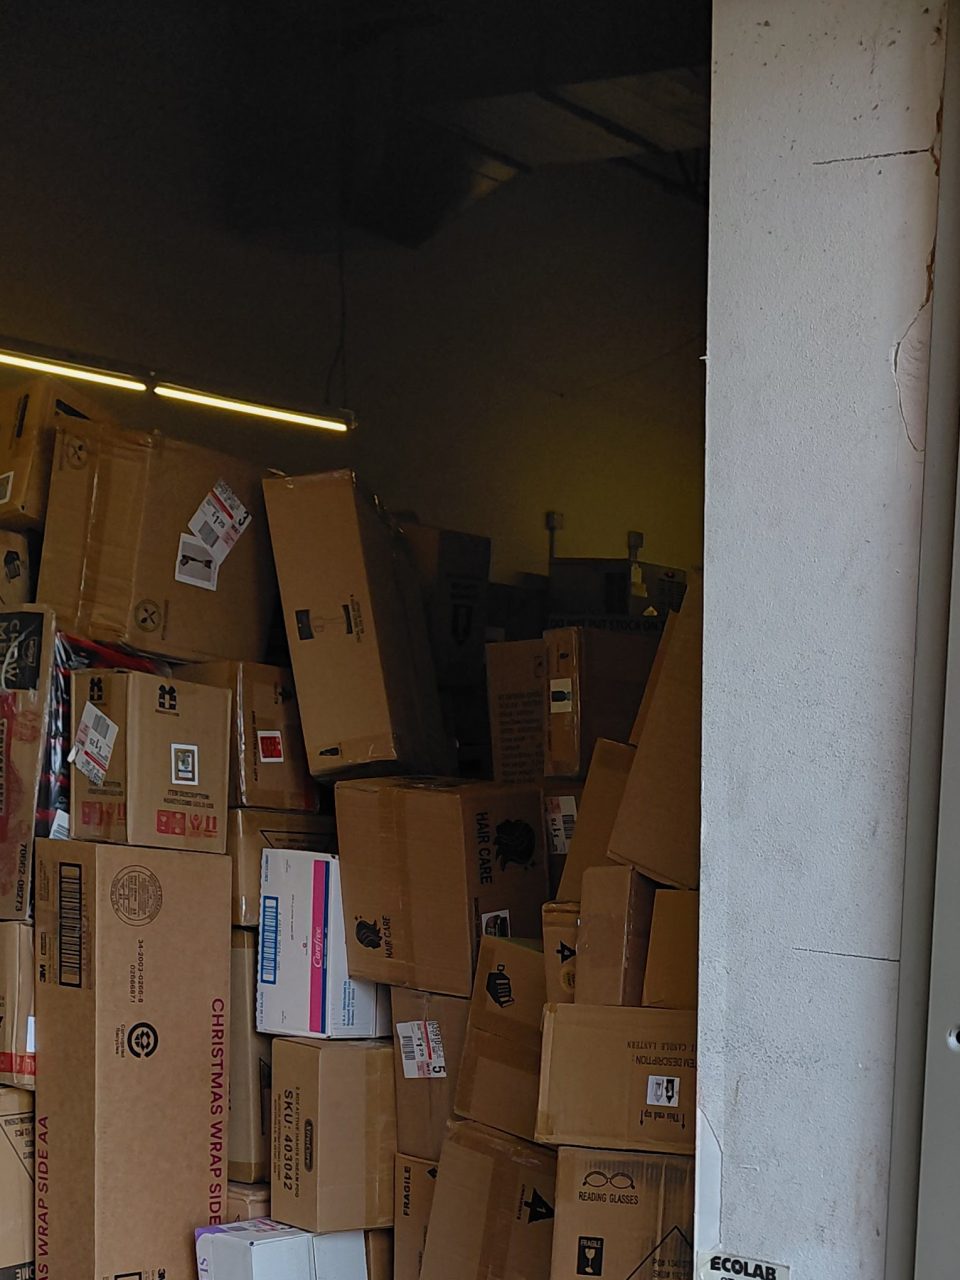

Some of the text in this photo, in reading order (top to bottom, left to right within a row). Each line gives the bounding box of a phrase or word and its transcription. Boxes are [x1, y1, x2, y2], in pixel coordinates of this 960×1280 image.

[476, 812, 493, 885] HAIR CARE
[312, 926, 322, 969] Carefree
[384, 940, 394, 959] HAIR
[432, 1065, 446, 1074] 5
[38, 1115, 49, 1145] AA
[209, 998, 225, 1225] CHRISTMAS WRAP SIDE
[283, 1089, 294, 1191] SKU: 403042
[38, 1148, 49, 1194] SIDE
[403, 1166, 412, 1217] FRAGILE
[578, 1191, 639, 1205] READING GLASSES
[38, 1198, 49, 1257] WRAP
[580, 1239, 602, 1248] FRAGILE
